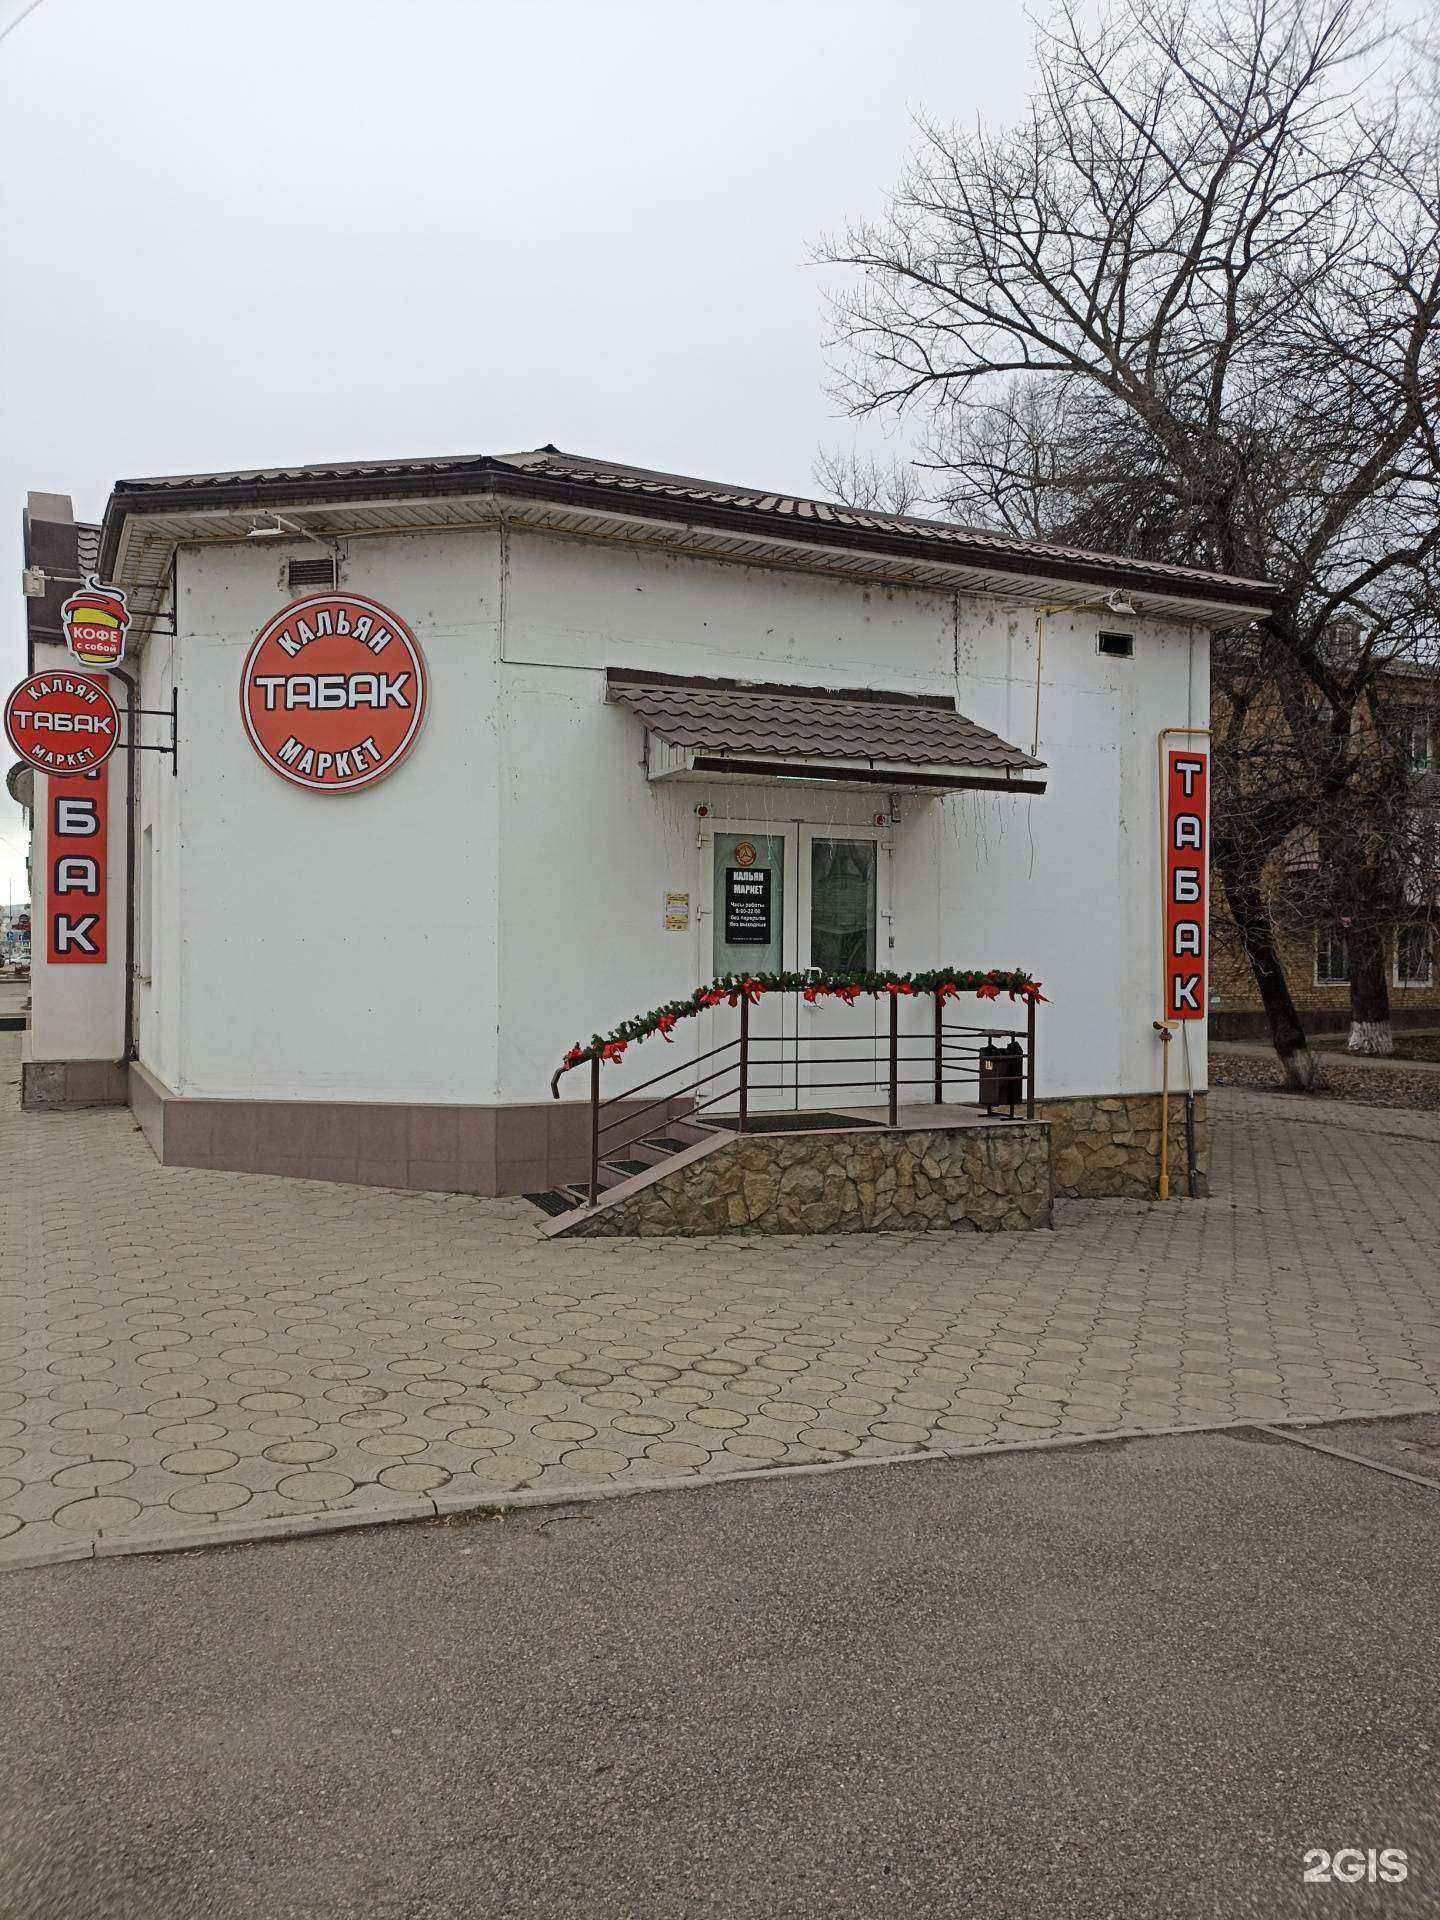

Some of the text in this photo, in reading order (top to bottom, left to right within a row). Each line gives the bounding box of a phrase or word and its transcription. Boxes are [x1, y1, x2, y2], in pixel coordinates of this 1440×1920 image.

[73, 627, 118, 643] КОФЕ
[76, 641, 117, 653] с собой
[276, 609, 393, 658] КАЛЬЯН
[27, 678, 99, 704] КАЛЬЯН
[255, 672, 411, 709] ТАБАК
[13, 710, 112, 735] ТАБАК
[31, 743, 96, 766] МАРКЕТ
[277, 735, 383, 777] МАРКЕТ
[54, 771, 100, 955] БАК
[1173, 760, 1203, 1009] ТАБАК
